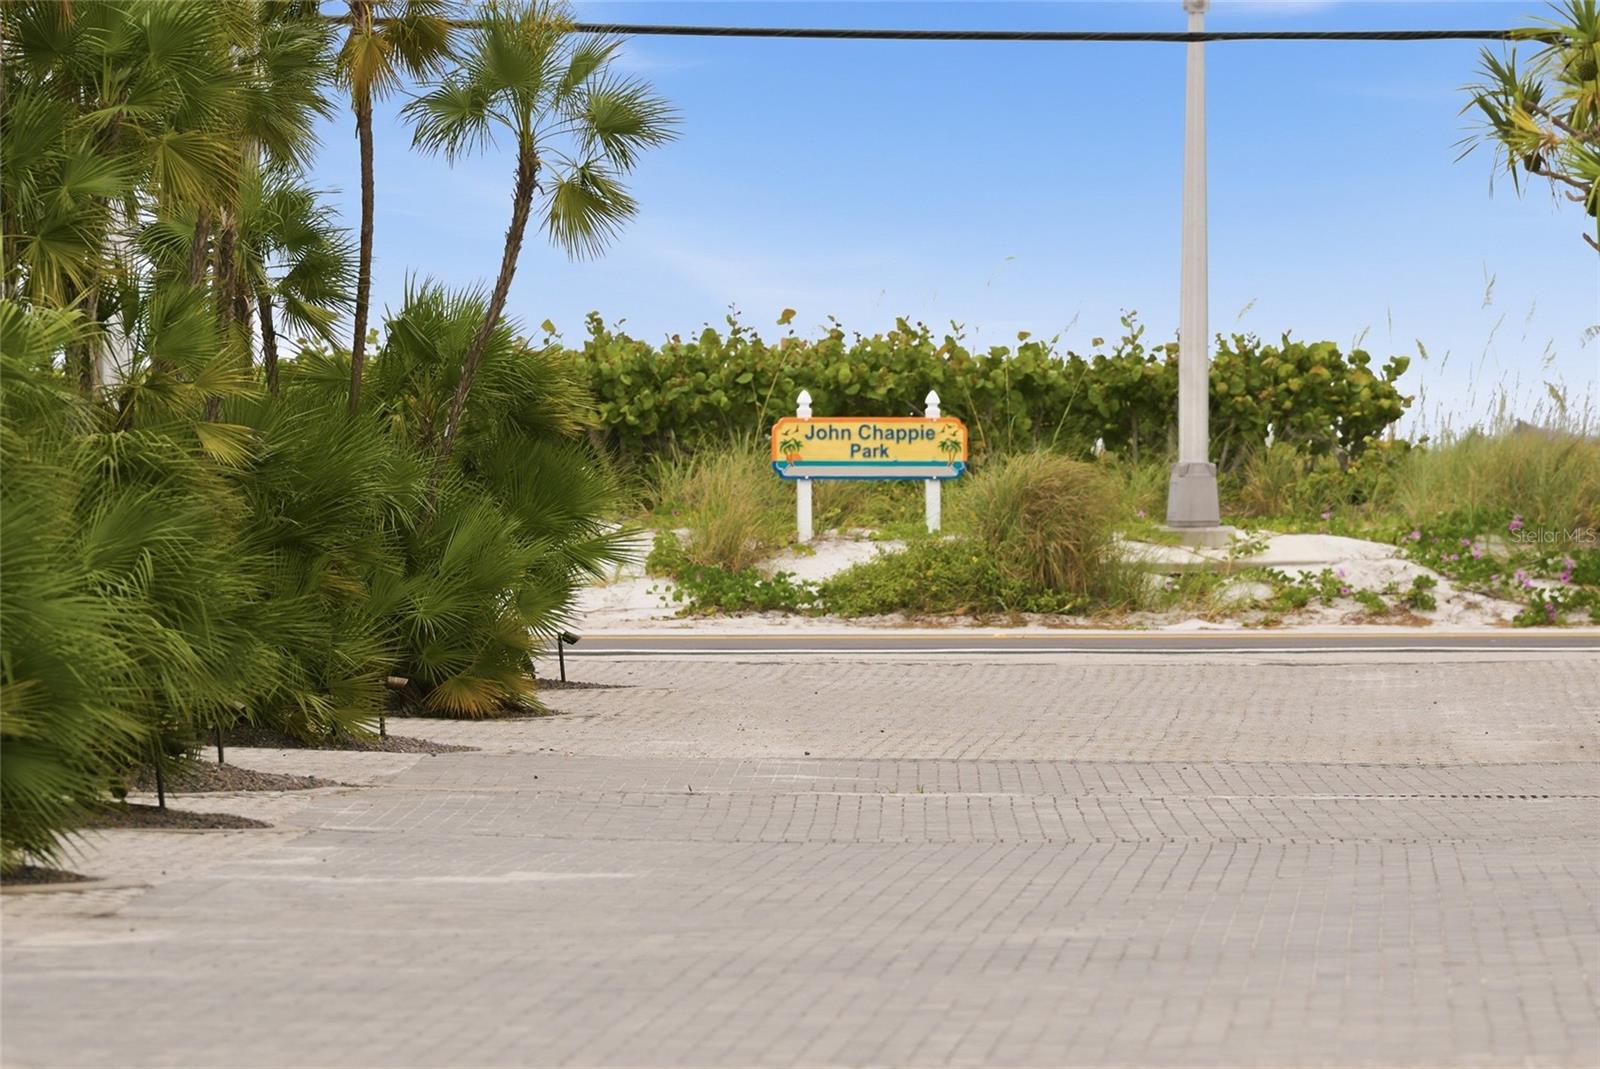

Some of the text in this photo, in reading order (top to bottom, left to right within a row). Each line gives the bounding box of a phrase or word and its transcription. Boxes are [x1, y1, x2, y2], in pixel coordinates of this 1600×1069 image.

[805, 424, 936, 443] John Chappie
[850, 444, 889, 458] Park
